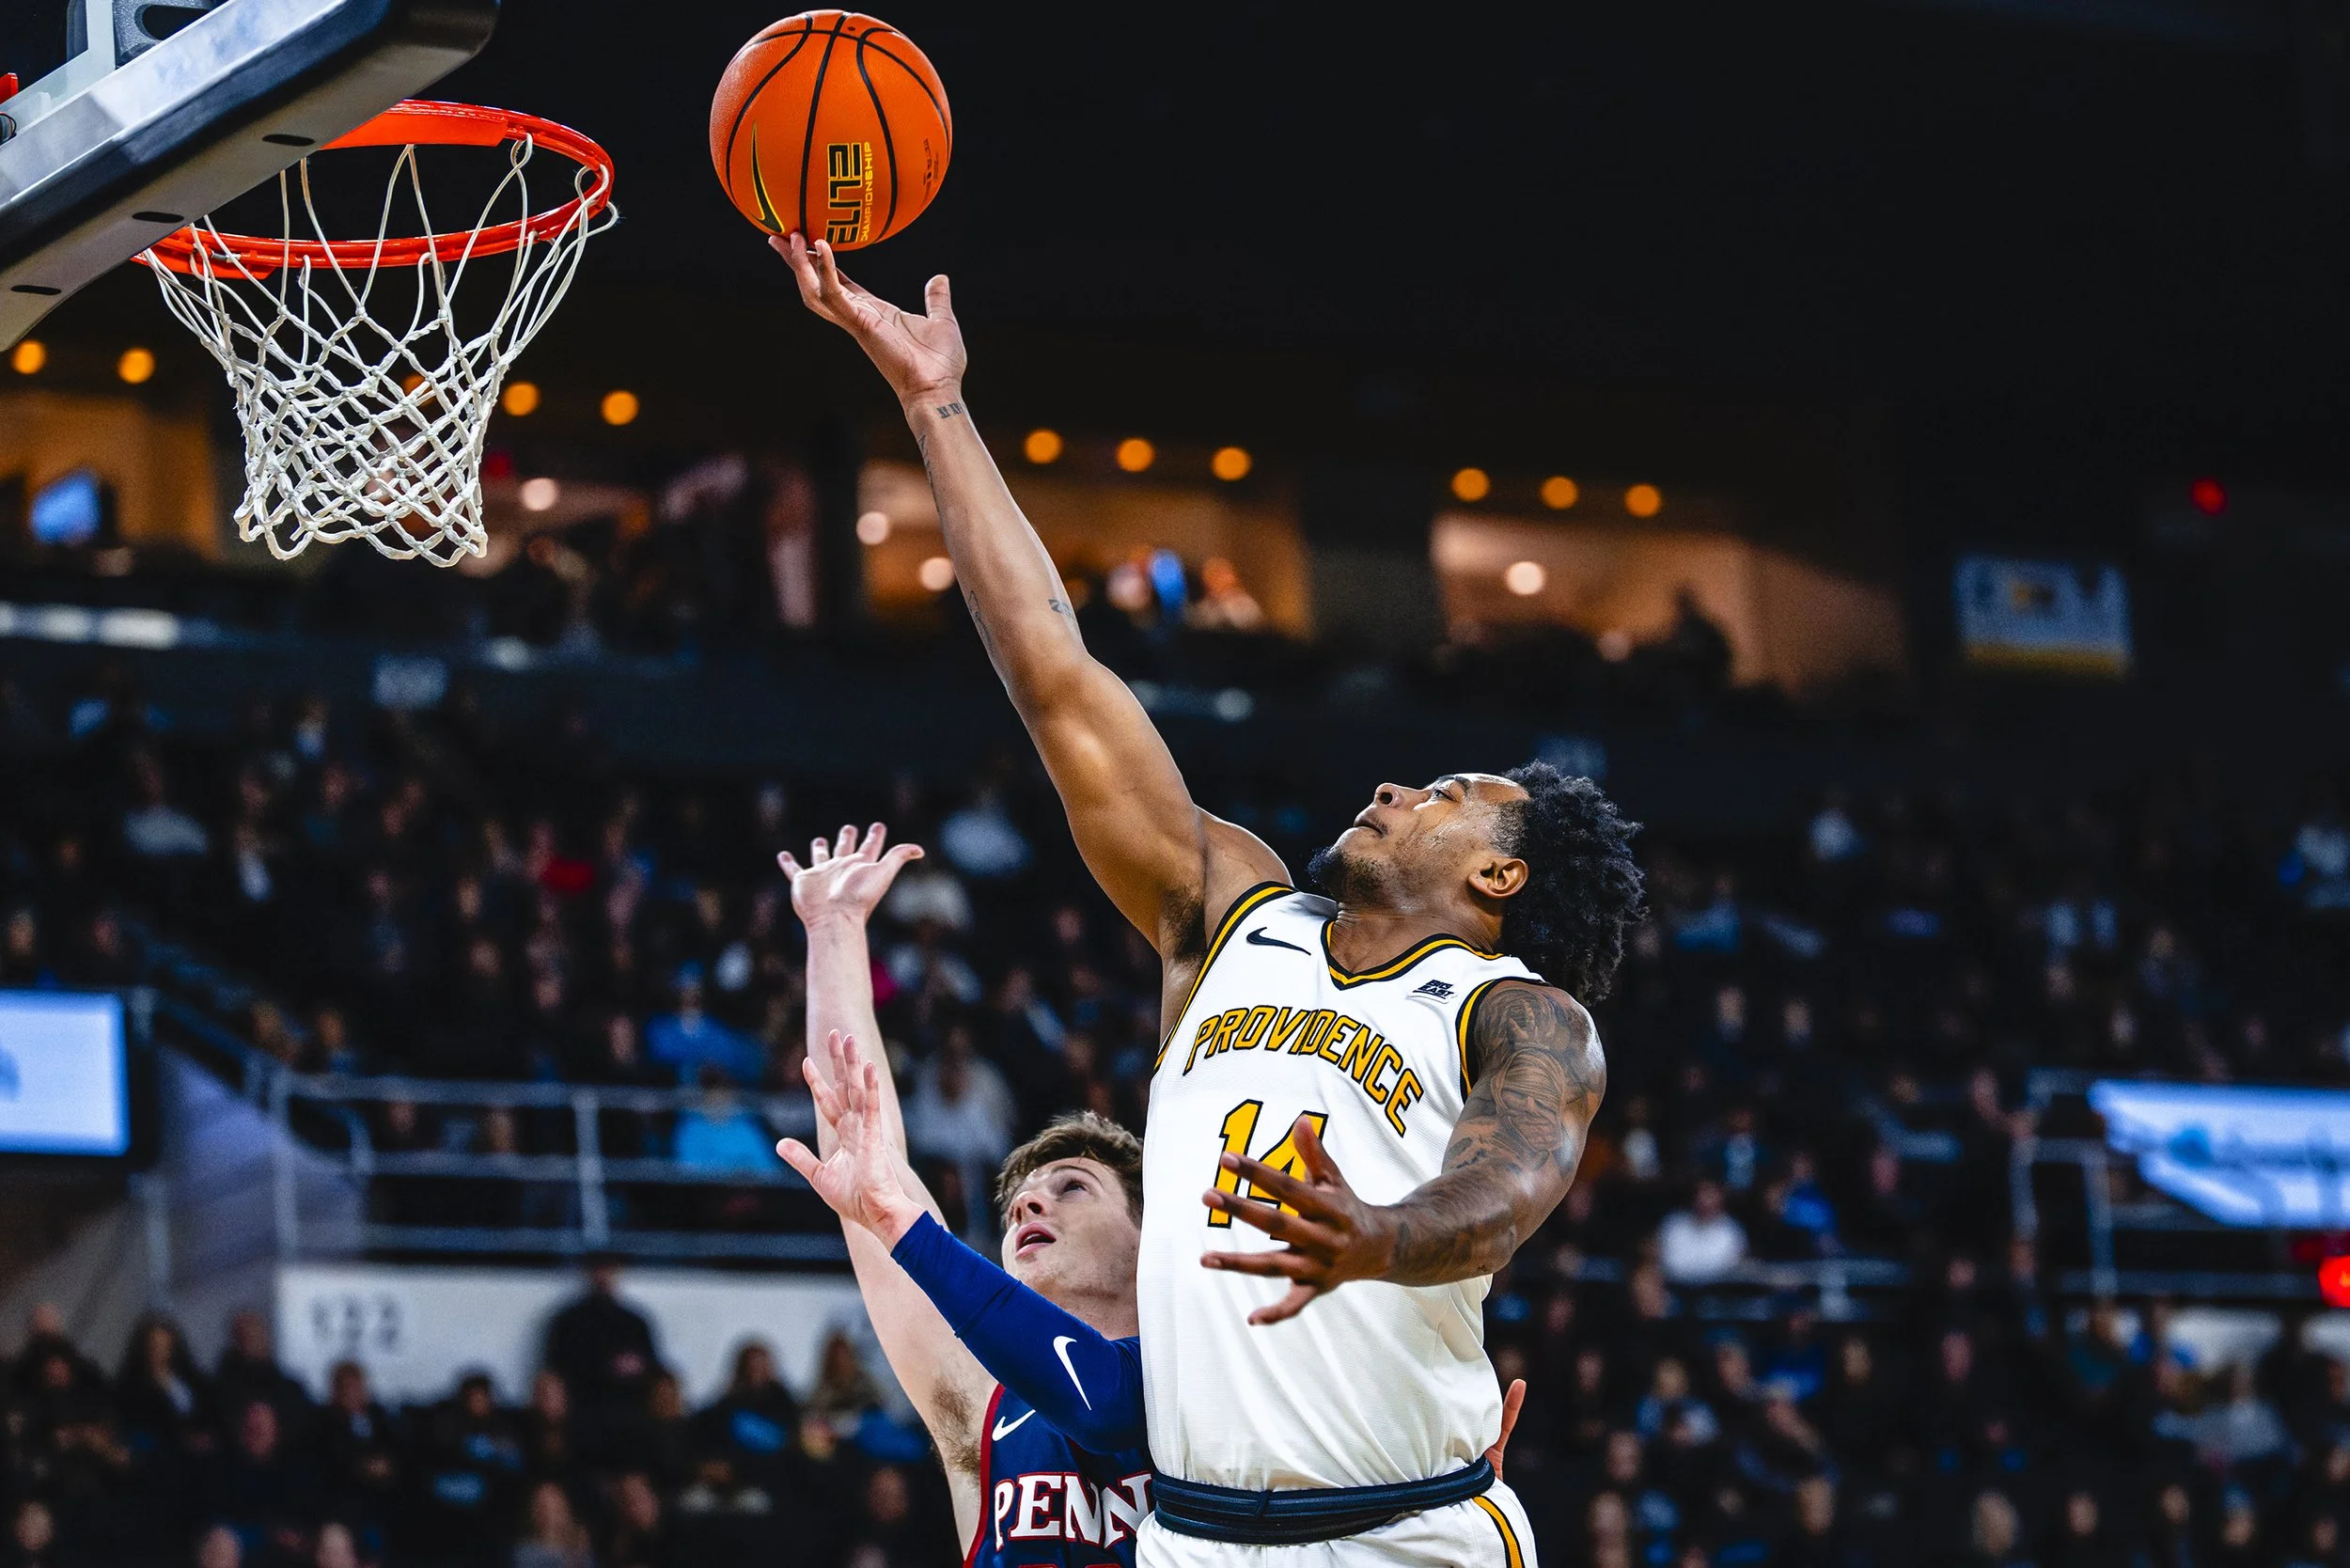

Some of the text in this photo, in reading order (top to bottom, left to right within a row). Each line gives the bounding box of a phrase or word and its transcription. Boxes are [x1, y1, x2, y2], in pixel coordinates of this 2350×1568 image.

[825, 143, 862, 243] ELITE
[860, 141, 873, 242] CHAMPIONSHIP
[1417, 984, 1455, 997] EAST
[1425, 979, 1454, 990] BIG
[1183, 1005, 1424, 1137] PROVIDENCE
[1207, 1099, 1330, 1241] 14
[994, 1471, 1153, 1552] PENN
